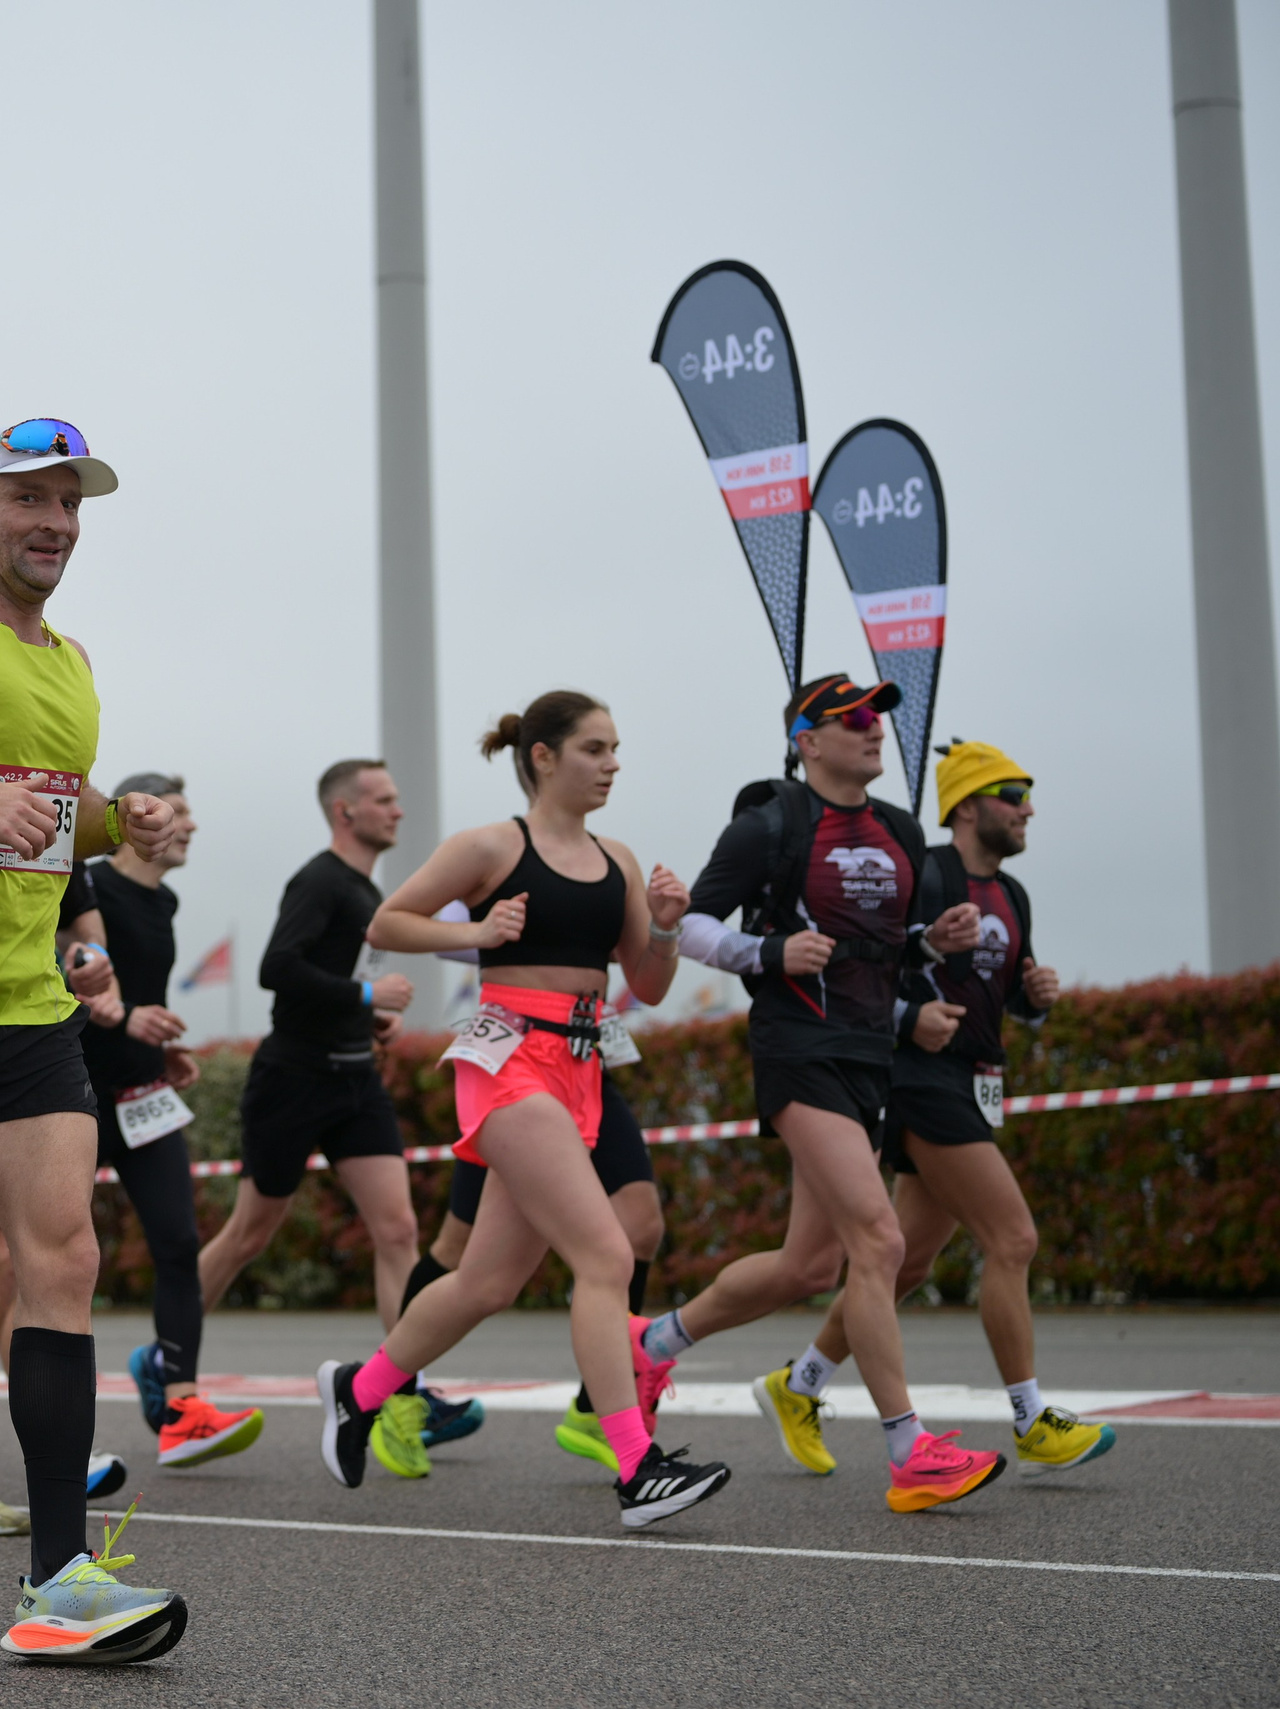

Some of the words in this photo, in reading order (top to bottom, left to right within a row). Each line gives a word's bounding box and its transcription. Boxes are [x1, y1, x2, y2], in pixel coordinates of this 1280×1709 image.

[4, 772, 23, 782] 42.2
[842, 880, 897, 892] SIRIUS
[124, 1095, 176, 1128] 8965
